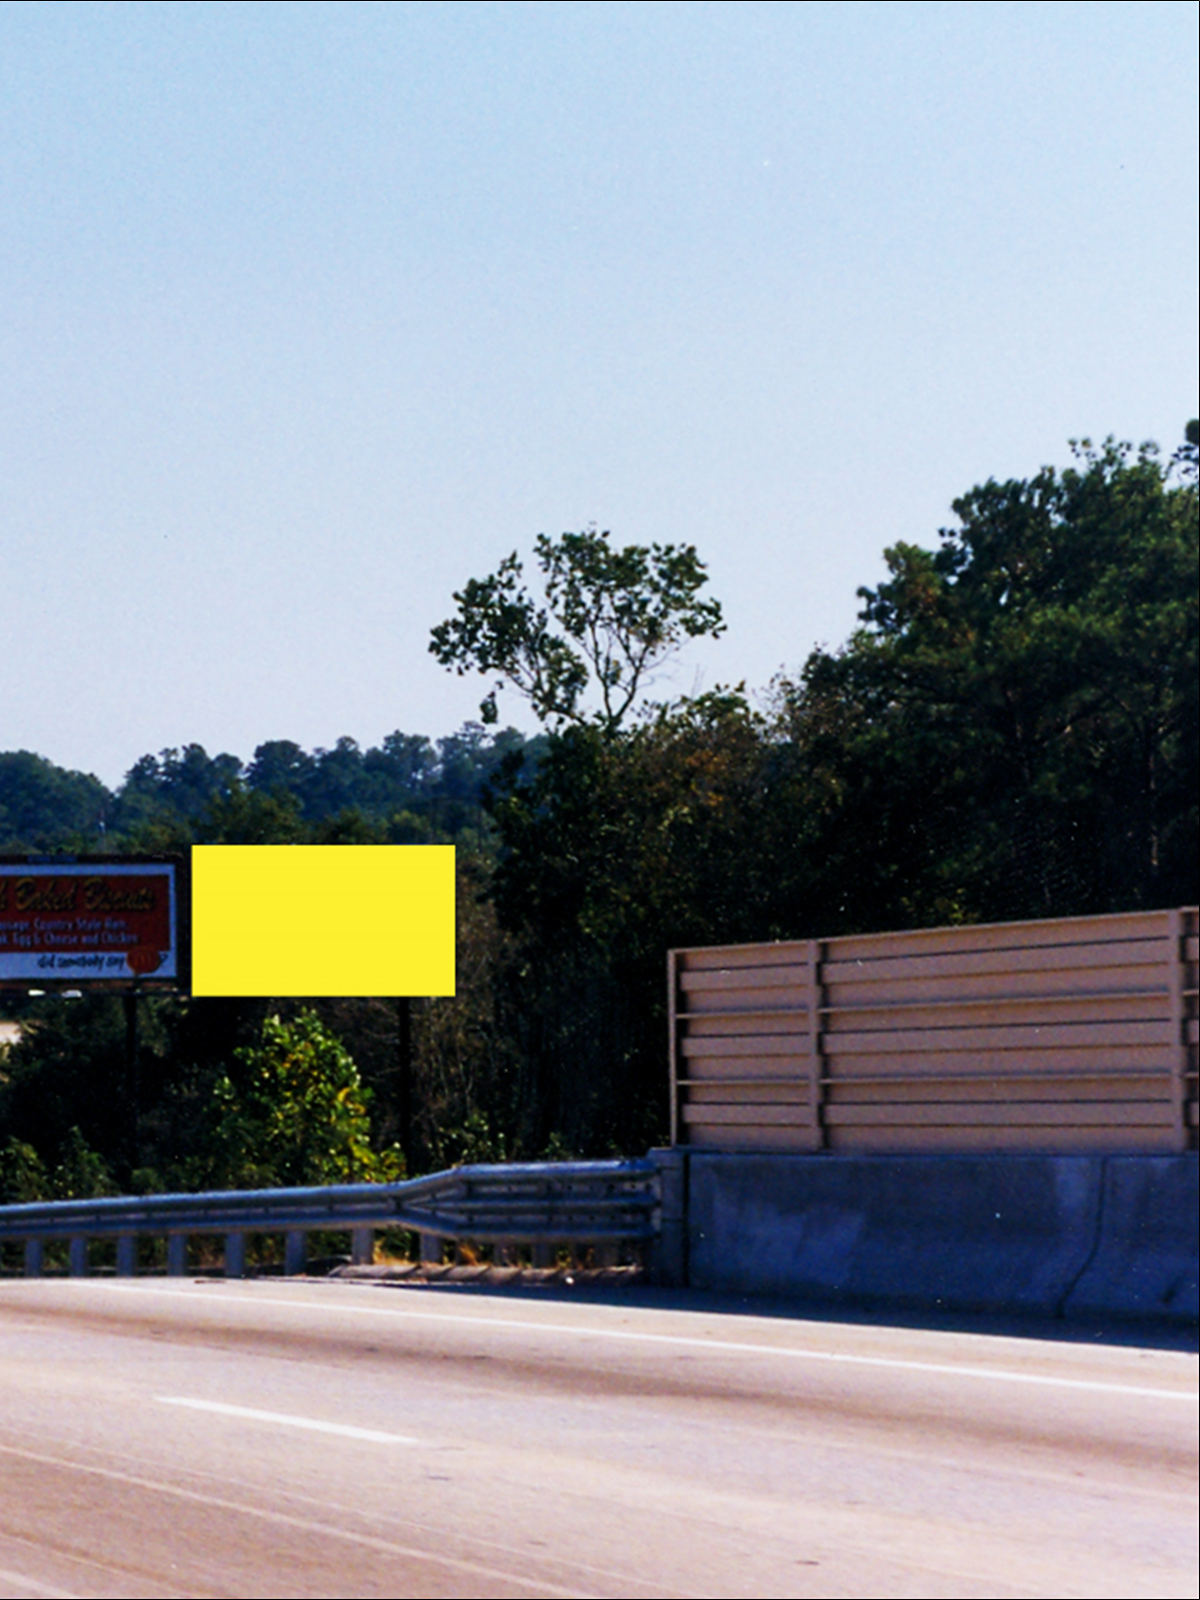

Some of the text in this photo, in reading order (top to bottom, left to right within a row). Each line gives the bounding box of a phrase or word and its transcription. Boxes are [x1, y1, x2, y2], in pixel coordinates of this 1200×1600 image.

[15, 877, 78, 911] Baked
[34, 918, 73, 932] Country
[75, 917, 101, 932] Style
[13, 932, 32, 947] Egg
[43, 931, 78, 945] Cheese
[81, 932, 99, 945] and
[101, 931, 139, 944] Chicken
[37, 954, 55, 969] did
